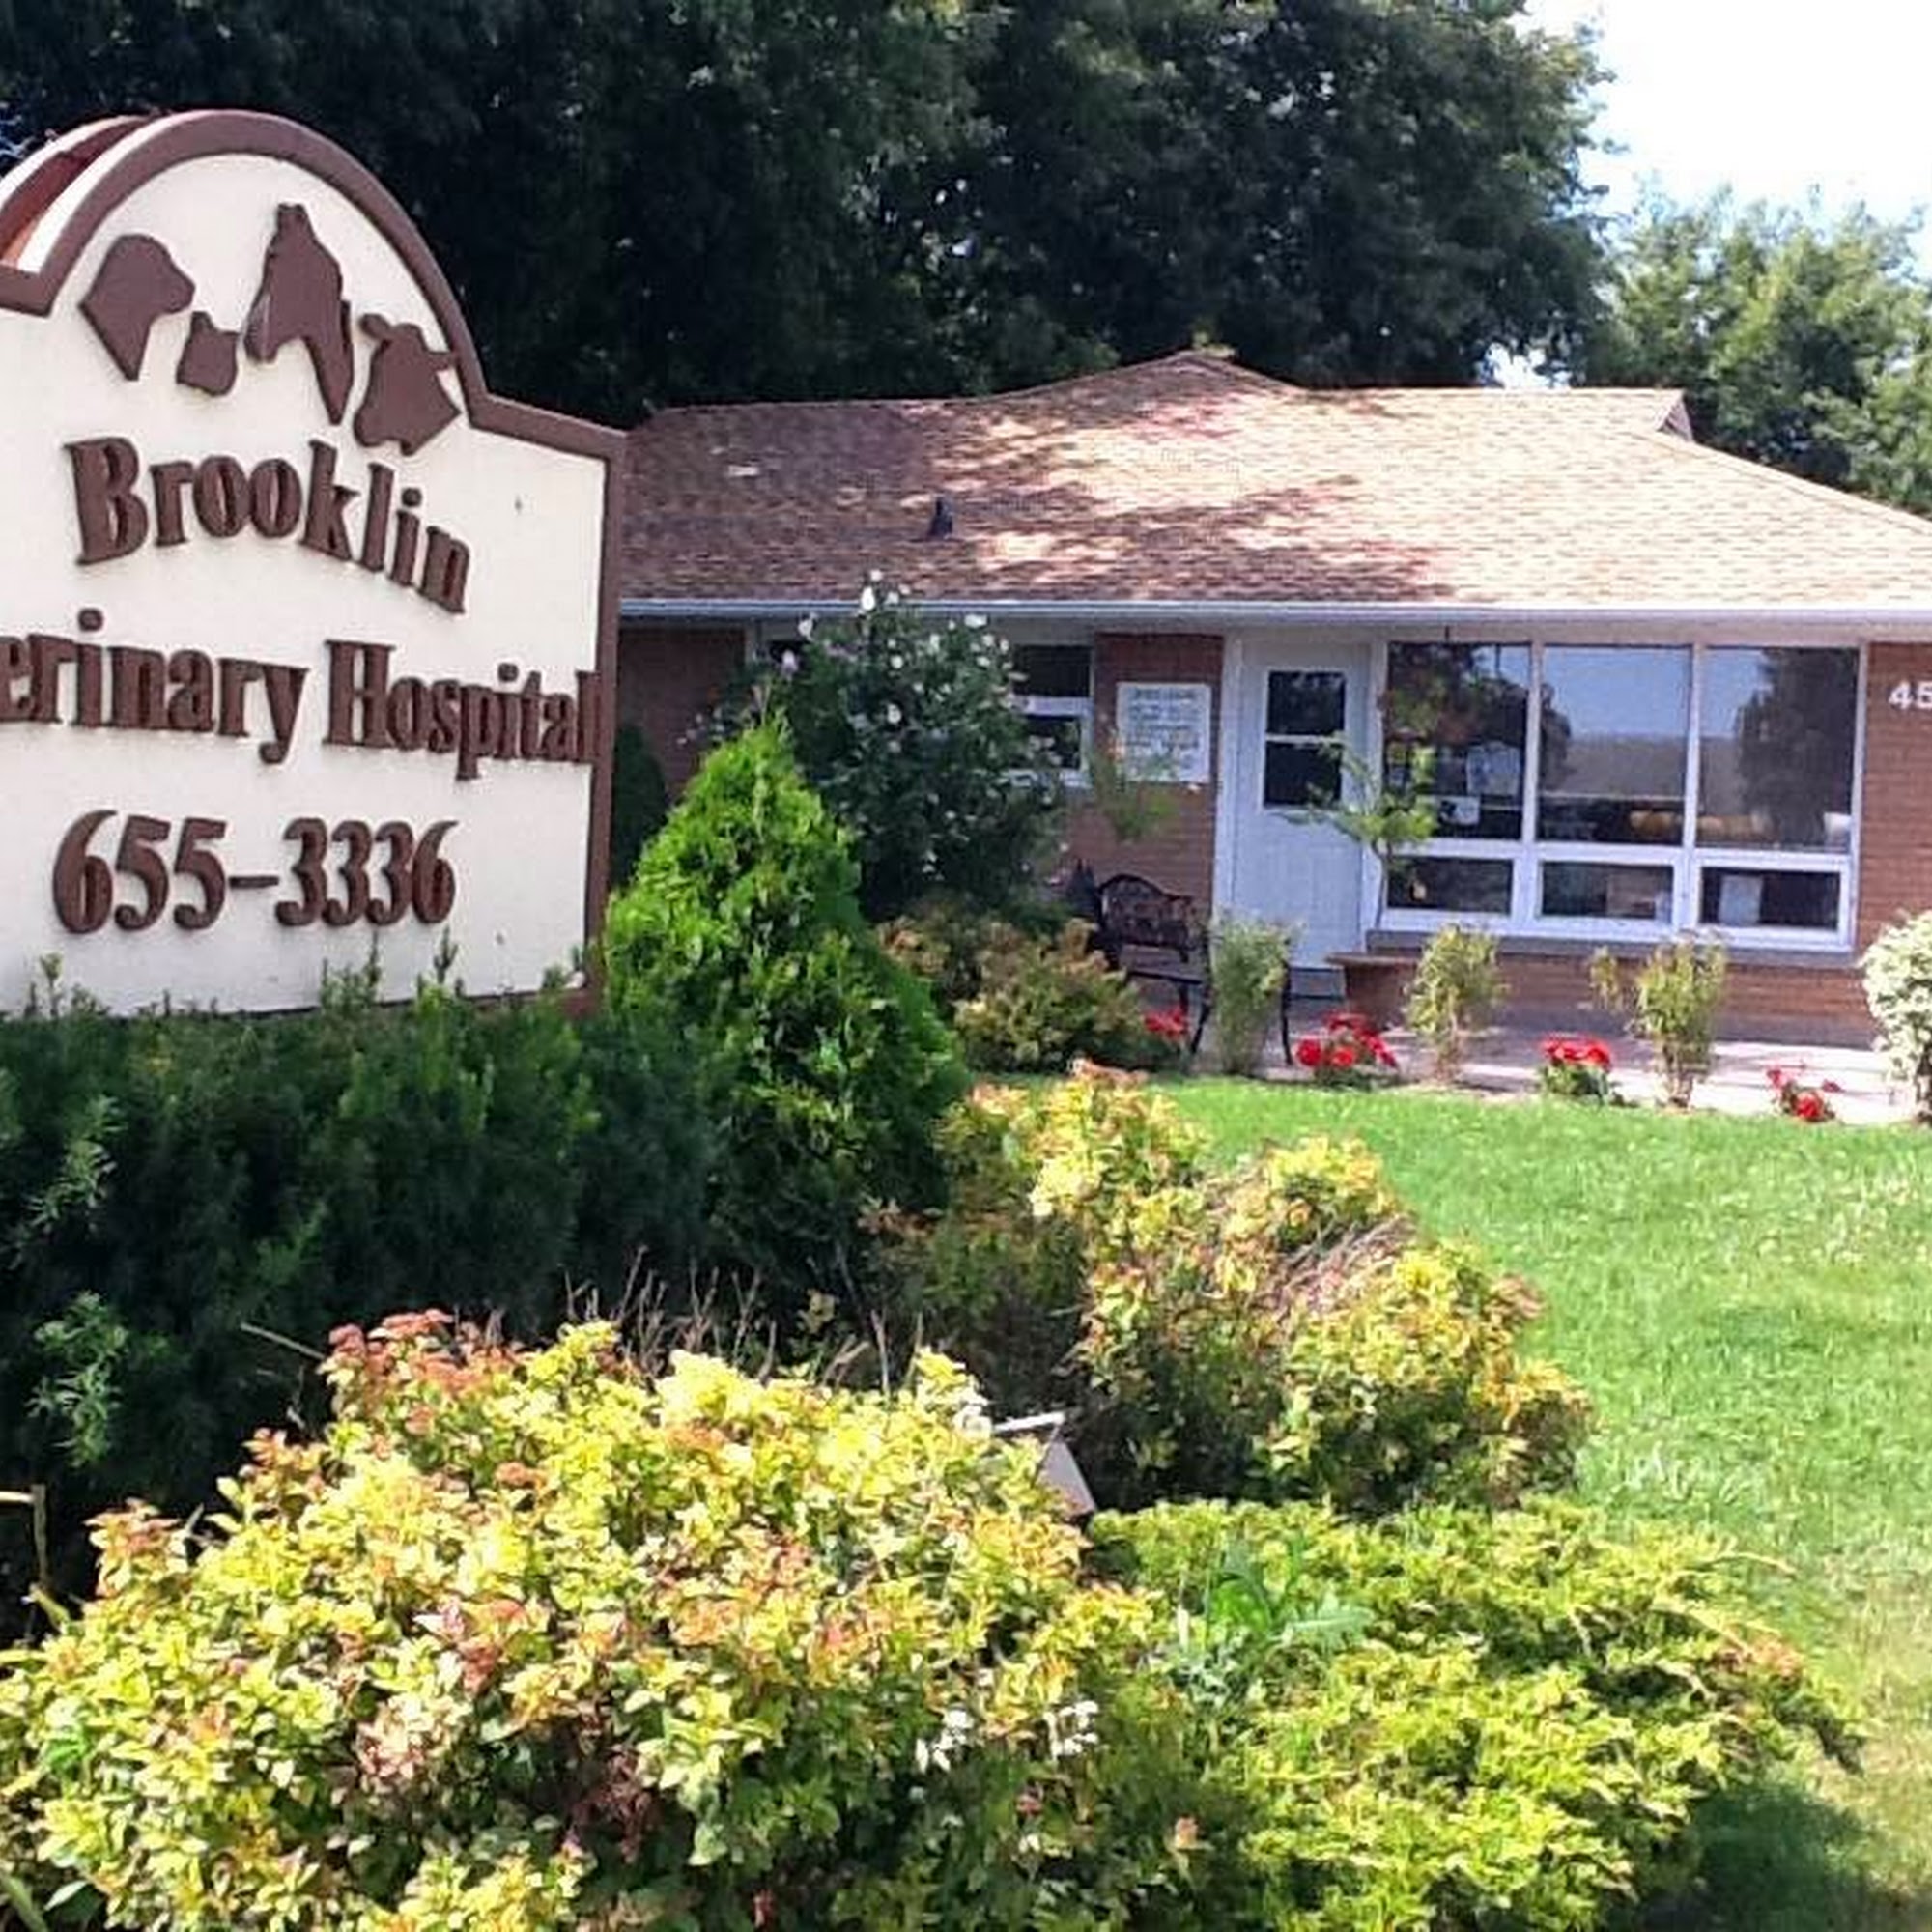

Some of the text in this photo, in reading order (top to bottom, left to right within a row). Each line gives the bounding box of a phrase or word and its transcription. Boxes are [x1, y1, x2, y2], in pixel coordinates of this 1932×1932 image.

[64, 437, 470, 615] Brooklin
[322, 639, 602, 781] Hospital
[52, 810, 459, 934] 655-3336
